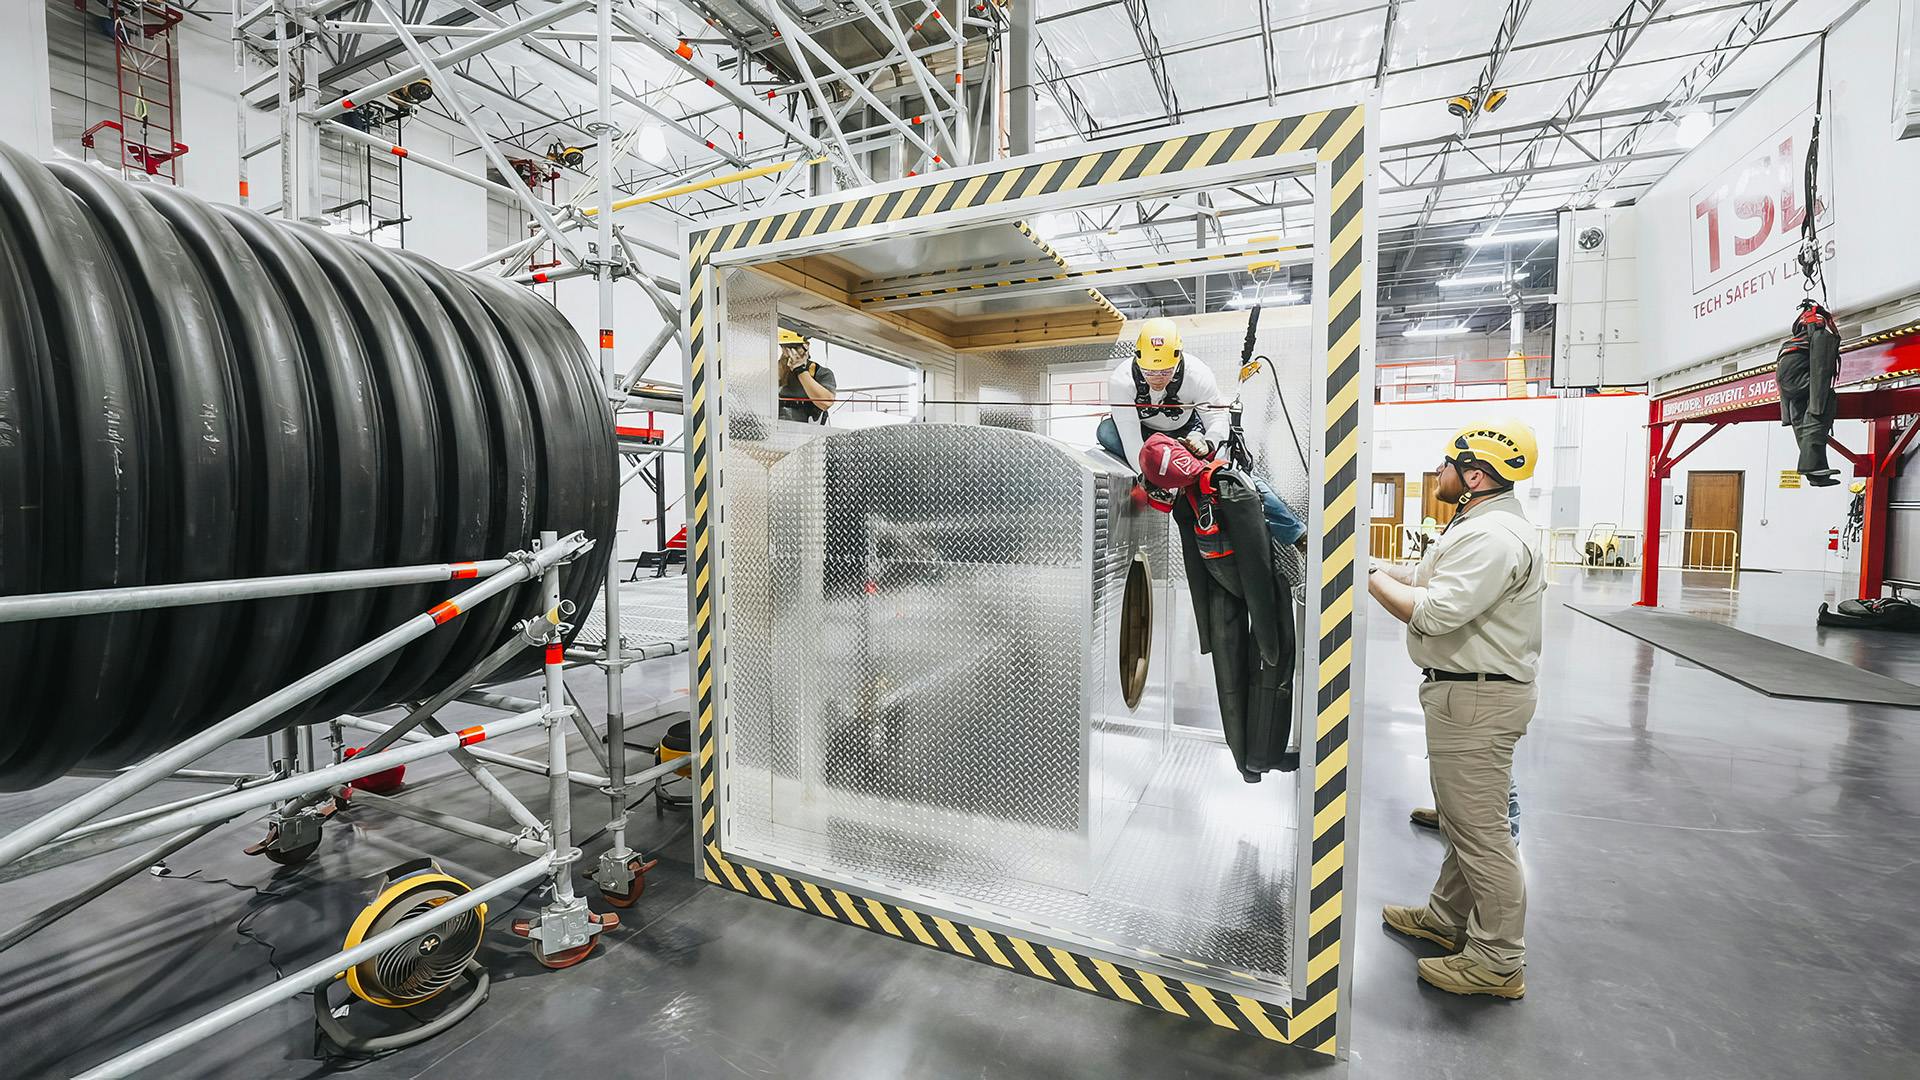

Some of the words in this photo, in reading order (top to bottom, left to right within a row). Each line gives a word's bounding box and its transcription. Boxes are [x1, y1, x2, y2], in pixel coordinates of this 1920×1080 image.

[1696, 136, 1825, 273] TSL
[1693, 294, 1722, 320] TECH
[1726, 267, 1777, 305] SAFETY
[1783, 239, 1837, 280] LIS
